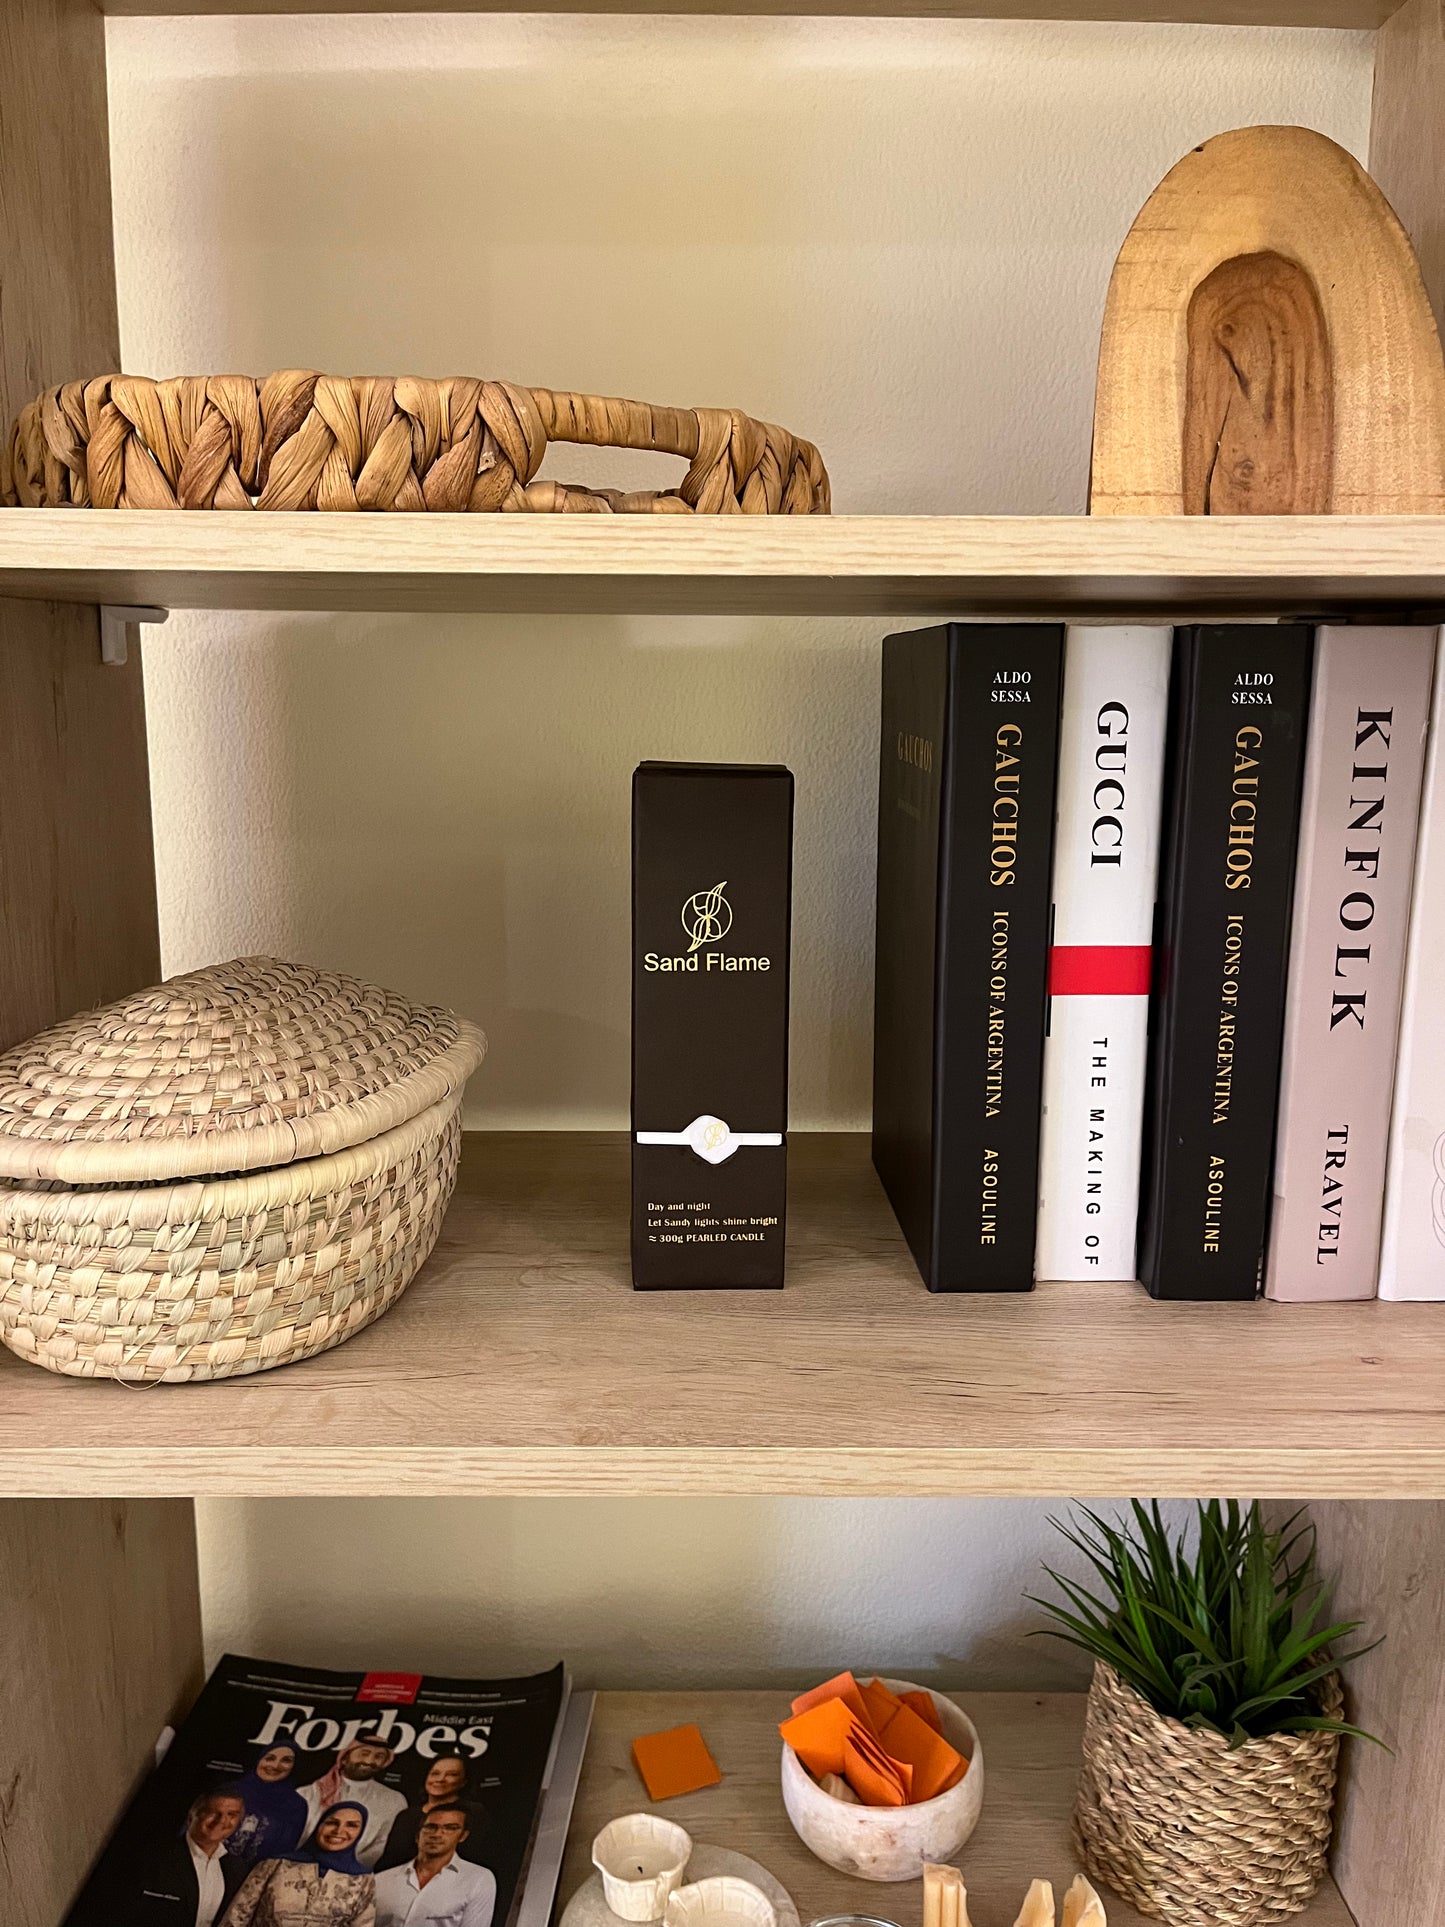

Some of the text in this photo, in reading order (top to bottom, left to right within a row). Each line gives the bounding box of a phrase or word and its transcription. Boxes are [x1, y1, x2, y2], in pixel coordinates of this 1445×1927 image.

[991, 691, 1030, 702] SESSA
[993, 672, 1031, 683] ALDO
[1232, 692, 1272, 704] SESSA
[1235, 674, 1273, 685] ALDO
[990, 724, 1022, 885] GAUCHOS
[1091, 702, 1128, 867] GUCCI
[1225, 727, 1262, 889] GAUCHOS
[1330, 706, 1394, 1033] KINFOLK
[645, 953, 770, 972] Sand Flame
[986, 912, 1008, 1117] ICONS OF ARGENTINA
[1213, 916, 1243, 1123] ICONS OF ARGENTINA
[1085, 1038, 1107, 1264] THE MAKING OF
[648, 1203, 710, 1212] Day and night
[649, 1217, 777, 1228] Let Sandy lights shine bright
[982, 1150, 998, 1244] ASOULINE
[1204, 1156, 1224, 1252] ASOULINE
[1317, 1125, 1348, 1264] TRAVEL
[660, 1235, 683, 1244] 300g
[687, 1234, 727, 1242] PEARLED
[731, 1233, 764, 1241] CANDLE
[248, 1701, 490, 1759] Forbes
[422, 1713, 494, 1725] Middle East
